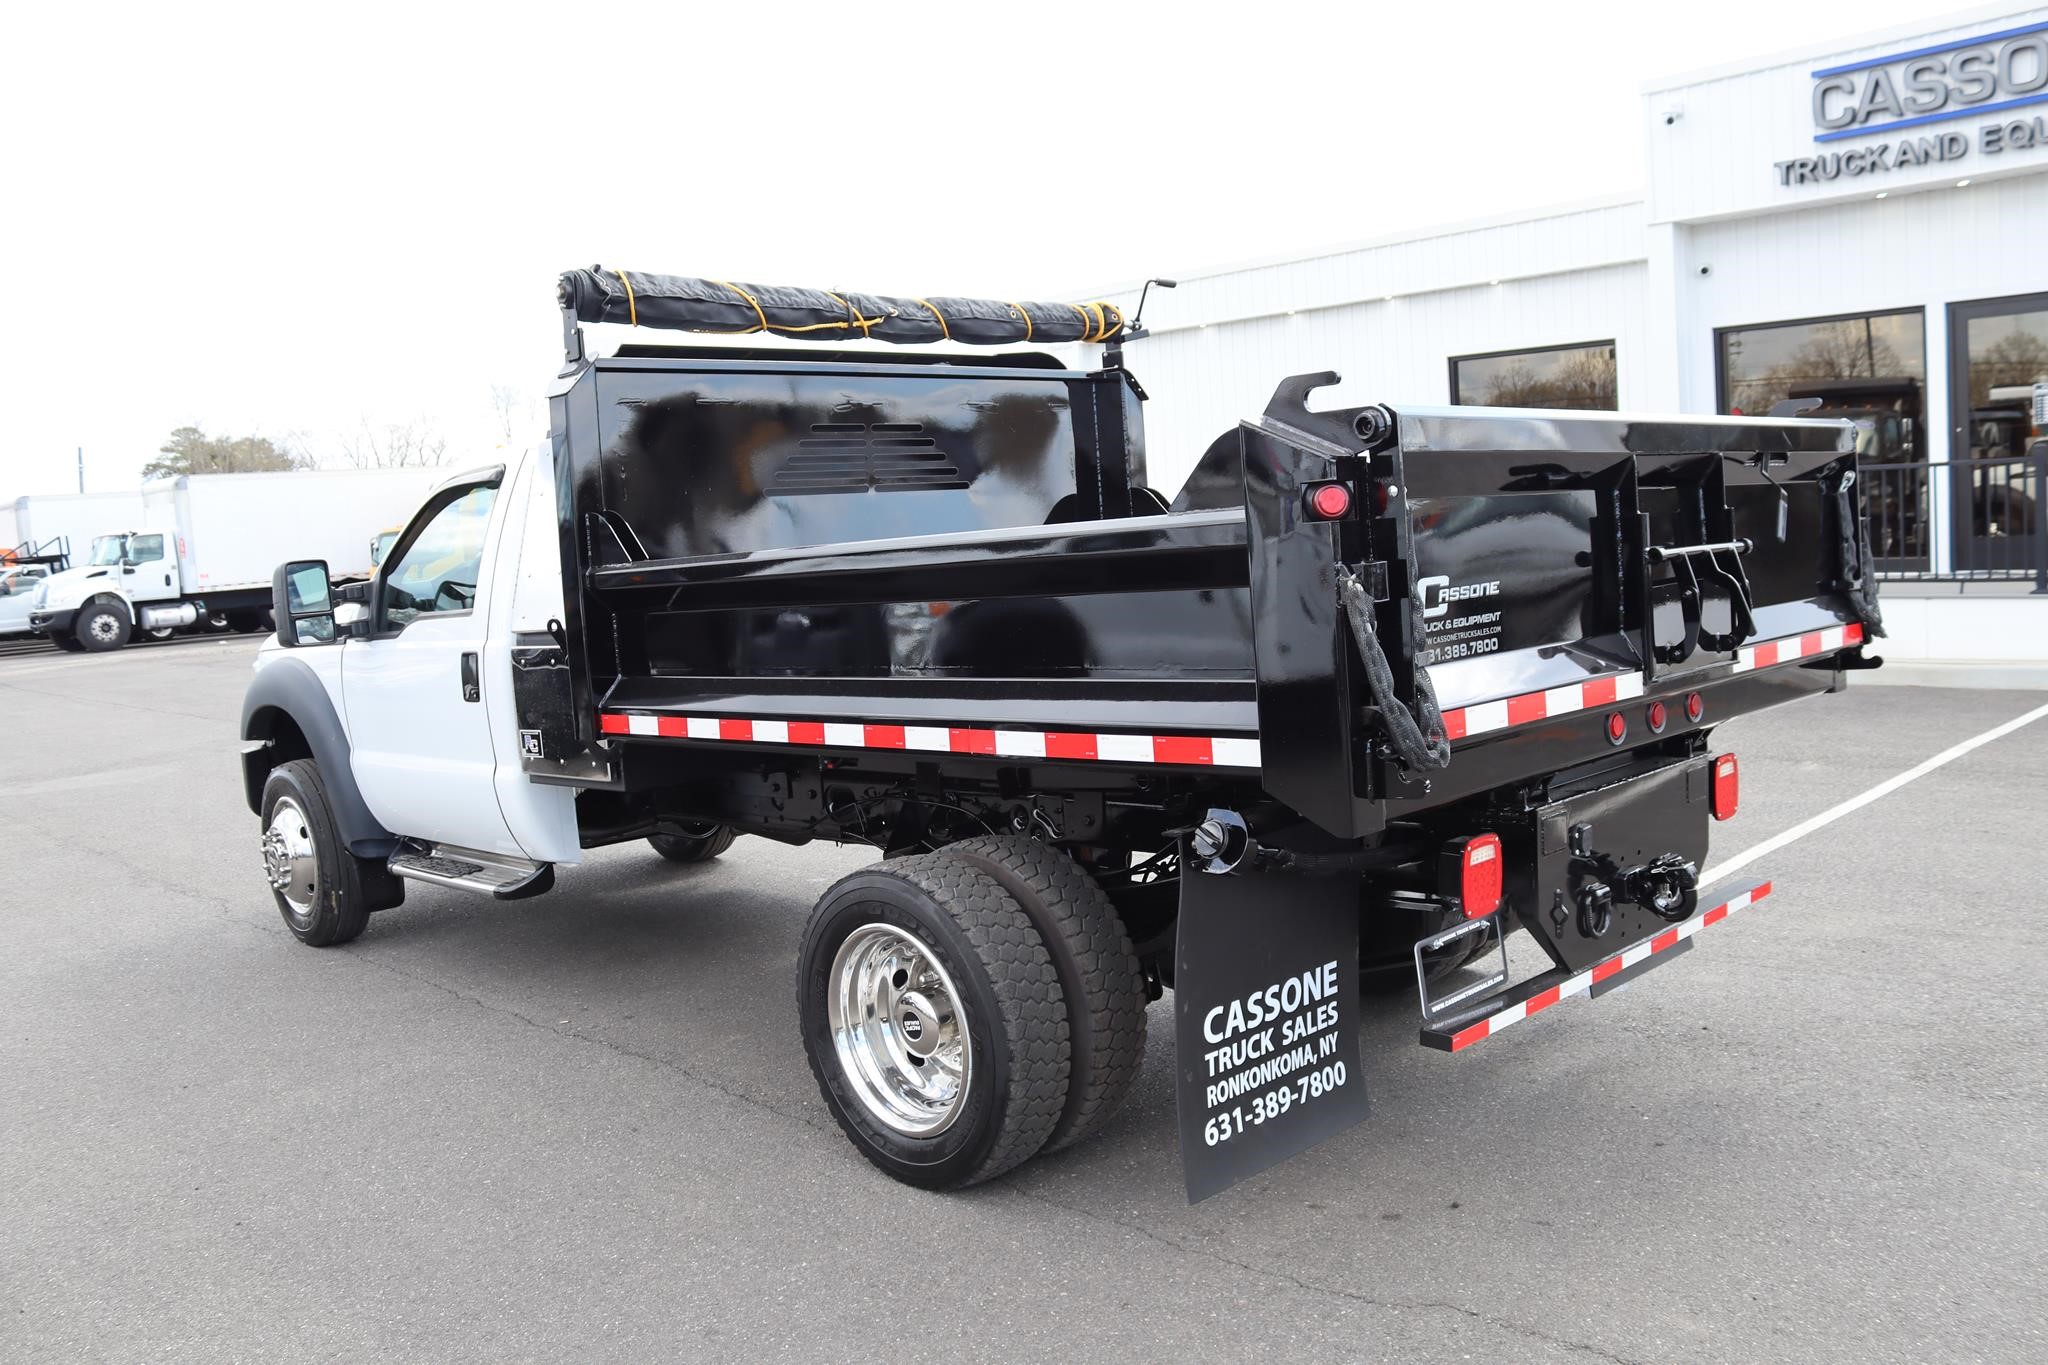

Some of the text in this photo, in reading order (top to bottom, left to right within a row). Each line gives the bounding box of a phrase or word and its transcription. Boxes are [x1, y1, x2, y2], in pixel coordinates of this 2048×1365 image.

[1812, 36, 2048, 130] CASSO
[1774, 144, 1891, 187] TRUCK
[1891, 131, 1969, 169] AND
[1424, 611, 1502, 633] UCK & EQUIPMENT
[1429, 637, 1499, 662] 31.389.7800
[1203, 960, 1338, 1044] CASSONE
[1204, 1001, 1339, 1077] TRUCK SALES
[1204, 1060, 1347, 1147] 631-389-7800
[1206, 1031, 1339, 1109] RONKONKOMA, NY
